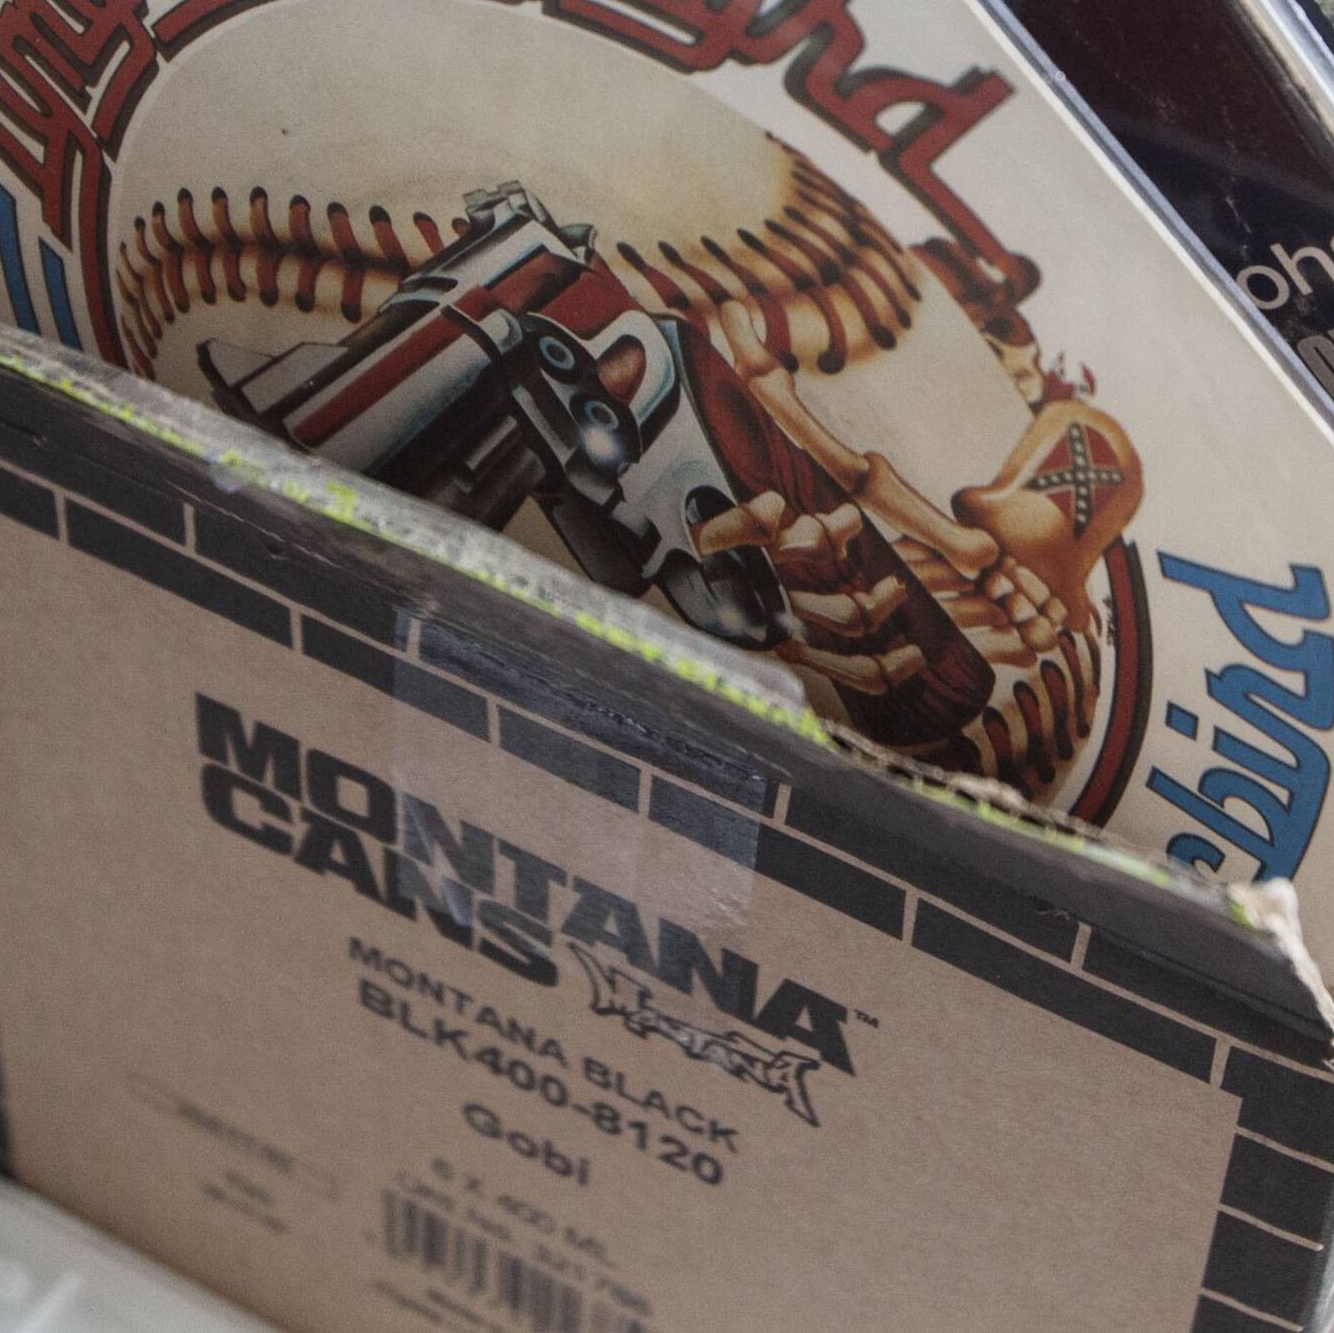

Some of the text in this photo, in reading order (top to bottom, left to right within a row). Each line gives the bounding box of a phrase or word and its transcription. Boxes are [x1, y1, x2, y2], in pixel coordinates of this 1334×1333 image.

[194, 691, 857, 1076] MONTANA
[199, 762, 559, 986] CANS
[348, 937, 566, 1069] MONTANA
[583, 1055, 740, 1152] BLACK
[357, 978, 726, 1187] BLK400-8120
[461, 1102, 590, 1188] Gobi
